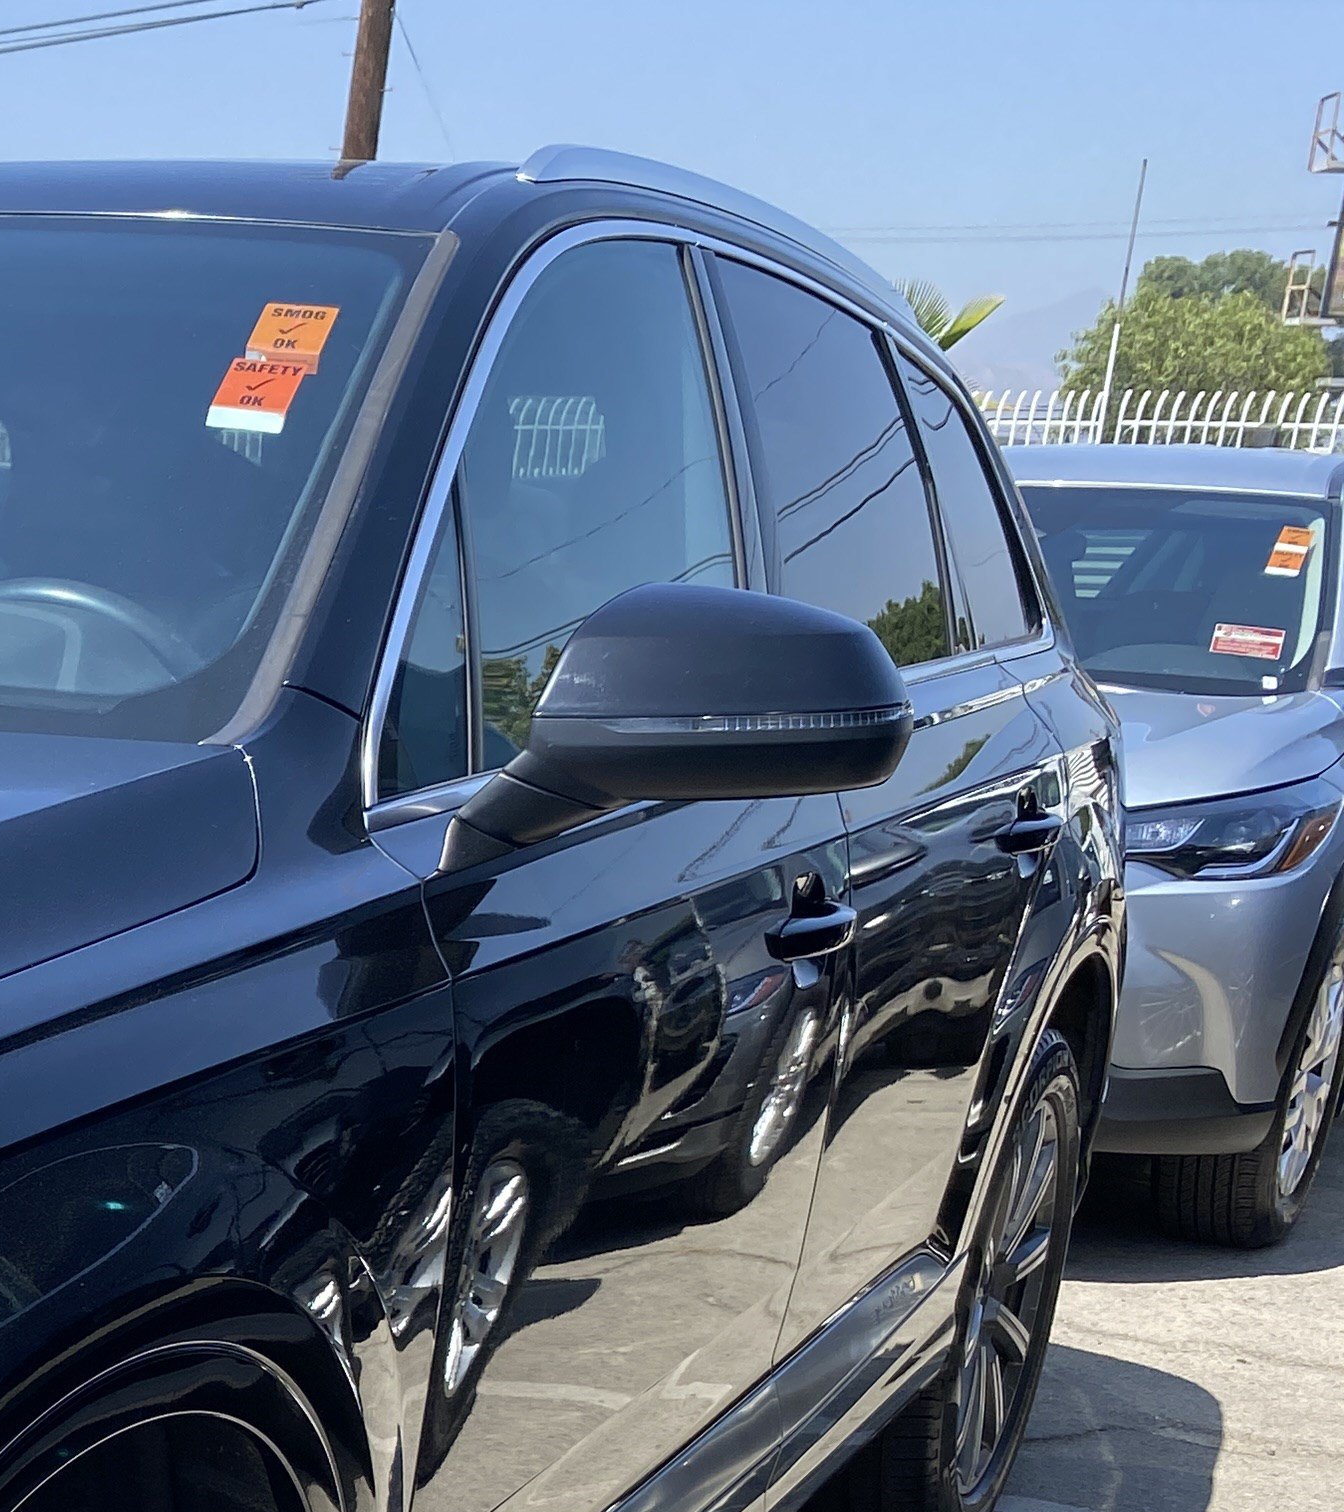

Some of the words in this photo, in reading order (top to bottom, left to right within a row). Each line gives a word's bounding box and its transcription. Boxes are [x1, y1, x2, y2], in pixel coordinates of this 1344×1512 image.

[271, 307, 328, 321] SMOG
[272, 337, 299, 350] OK
[233, 361, 304, 376] SAFETY
[238, 395, 266, 407] OK
